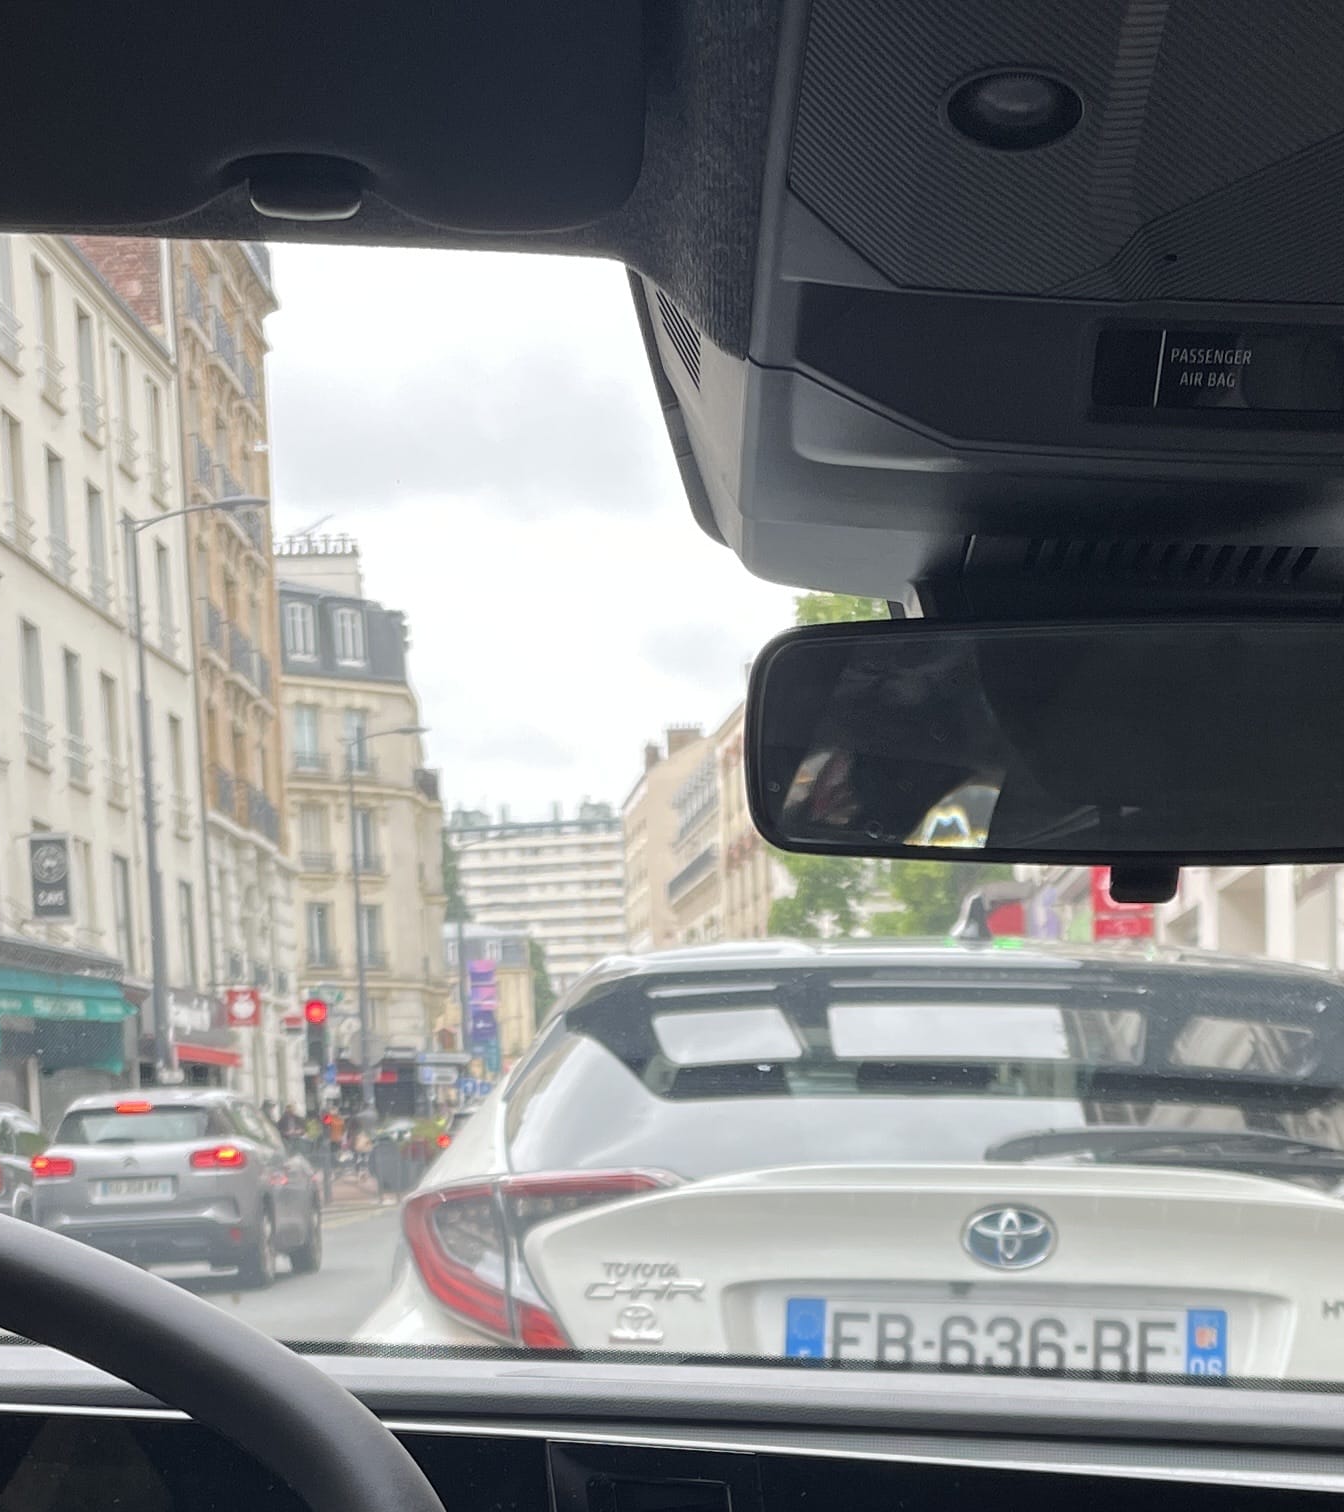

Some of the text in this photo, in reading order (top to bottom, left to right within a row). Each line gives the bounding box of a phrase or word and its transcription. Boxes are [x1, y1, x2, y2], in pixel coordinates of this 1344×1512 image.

[1171, 347, 1252, 365] PASSENGER
[1179, 371, 1236, 388] AIR BAG
[603, 1262, 680, 1278] TOYOTA
